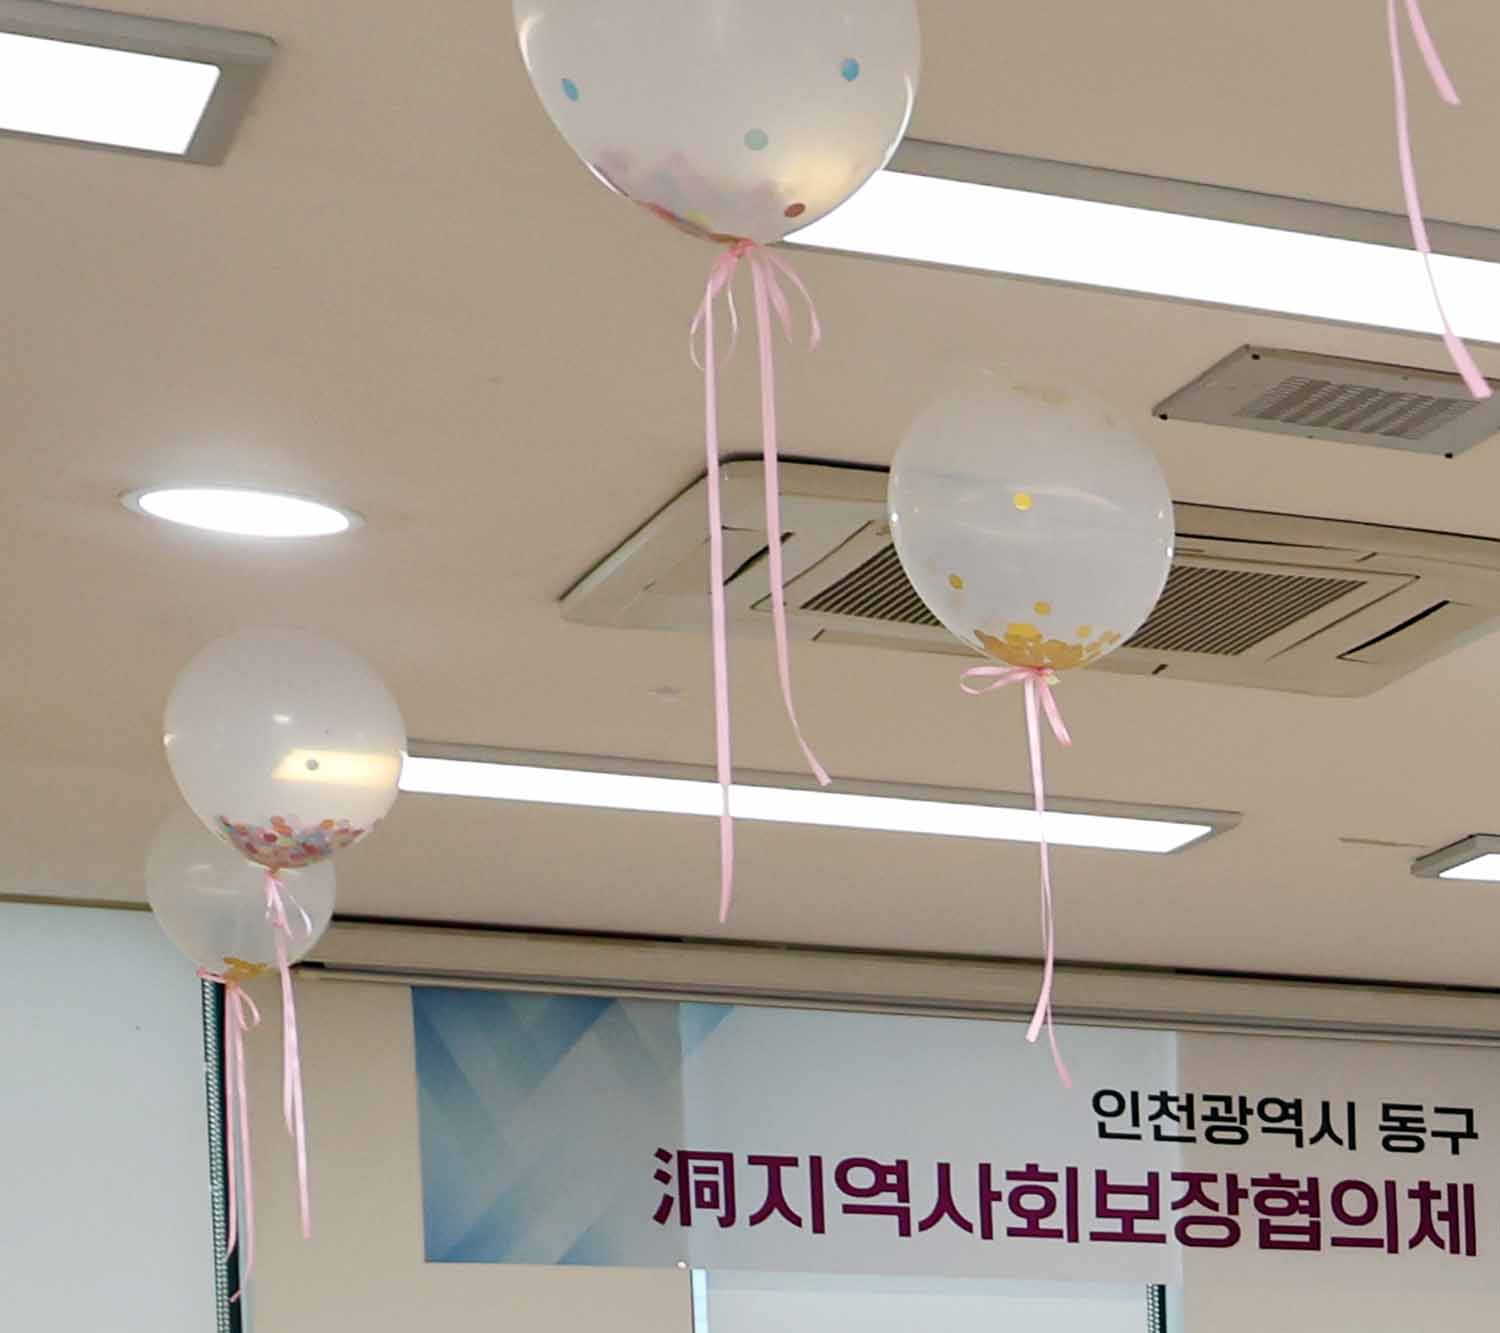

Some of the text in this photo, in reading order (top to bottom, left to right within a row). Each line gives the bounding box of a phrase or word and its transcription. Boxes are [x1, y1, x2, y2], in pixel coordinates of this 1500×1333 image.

[1092, 1087, 1479, 1155] 인천광역시 동구
[652, 1147, 1478, 1257] 洞지역사회보장협의체
